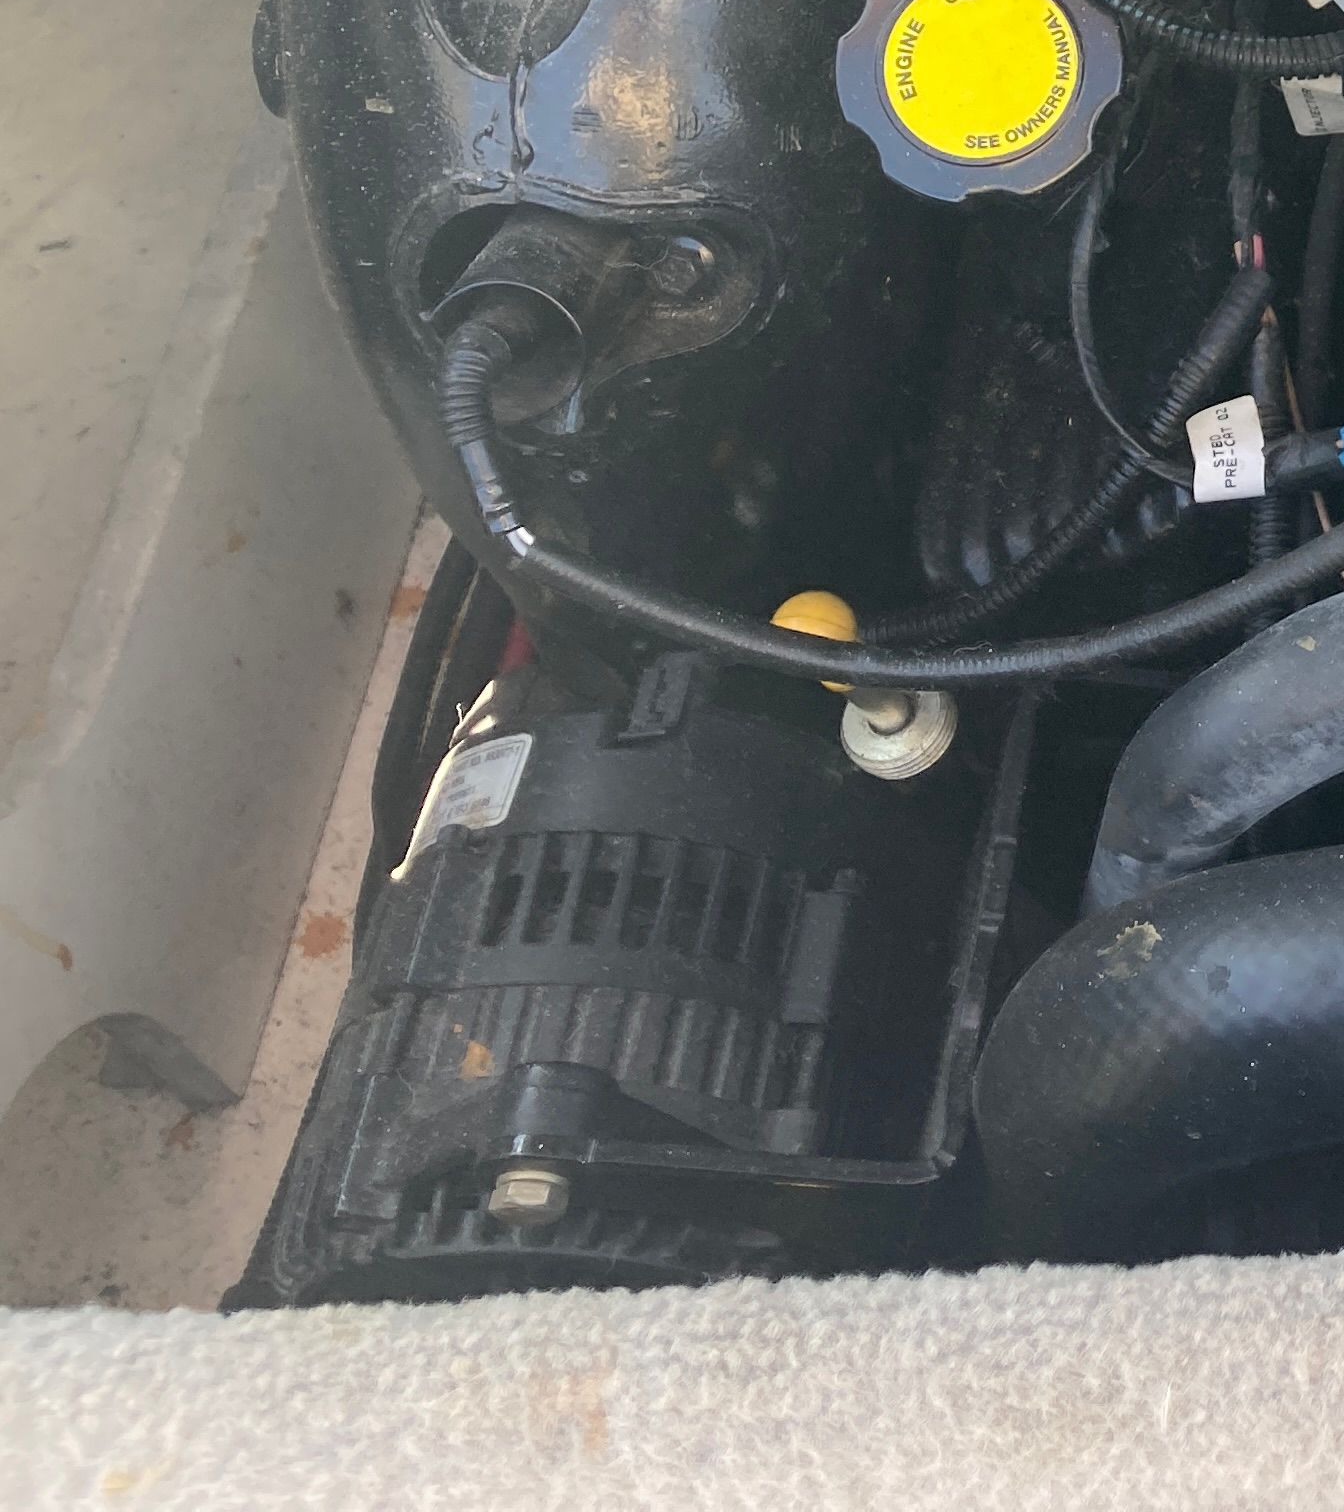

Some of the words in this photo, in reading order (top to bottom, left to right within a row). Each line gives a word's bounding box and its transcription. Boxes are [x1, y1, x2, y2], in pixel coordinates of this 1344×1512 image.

[896, 17, 925, 101] ENGINE
[964, 134, 1001, 149] SEE
[1005, 84, 1066, 144] OWNERS
[1042, 7, 1071, 80] MANUAL
